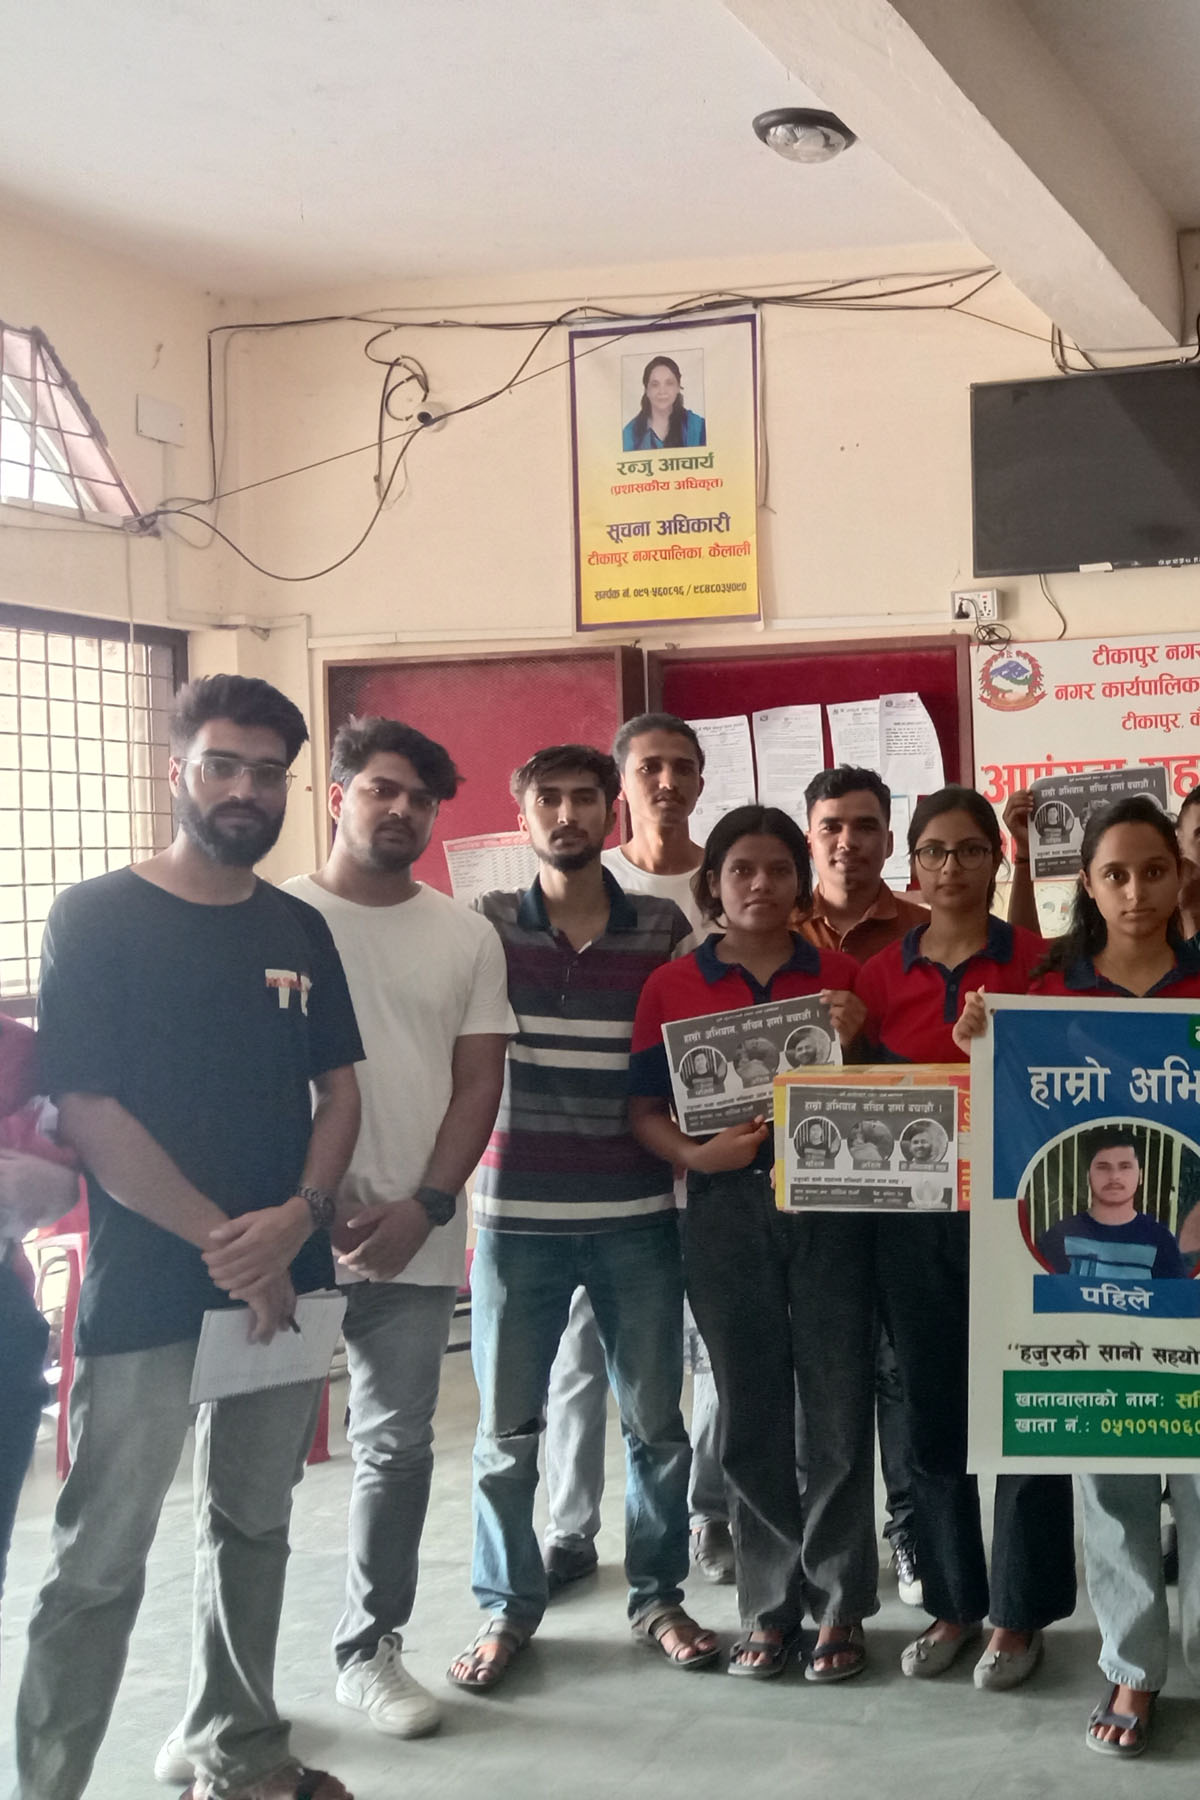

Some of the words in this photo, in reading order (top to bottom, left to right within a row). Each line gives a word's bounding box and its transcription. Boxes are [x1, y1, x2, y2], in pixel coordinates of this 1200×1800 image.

[616, 459, 655, 477] रन्जु
[658, 452, 715, 472] आचार्य
[611, 479, 670, 497] (प्रशासकीय
[674, 477, 724, 492] अधिकृत)
[606, 520, 651, 543] सूचना
[656, 512, 731, 536] अधिकारी
[587, 551, 629, 567] टीकापुर
[708, 541, 751, 558] कैलाली
[1092, 644, 1159, 668] टीकापुर
[1054, 683, 1096, 701] नगर
[1027, 1056, 1112, 1110] हाम्रो
[1080, 1285, 1154, 1312] पहिले
[1098, 1341, 1143, 1363] सानो
[1015, 1390, 1118, 1408] खातावालाको
[1014, 1417, 1058, 1434] खाता
